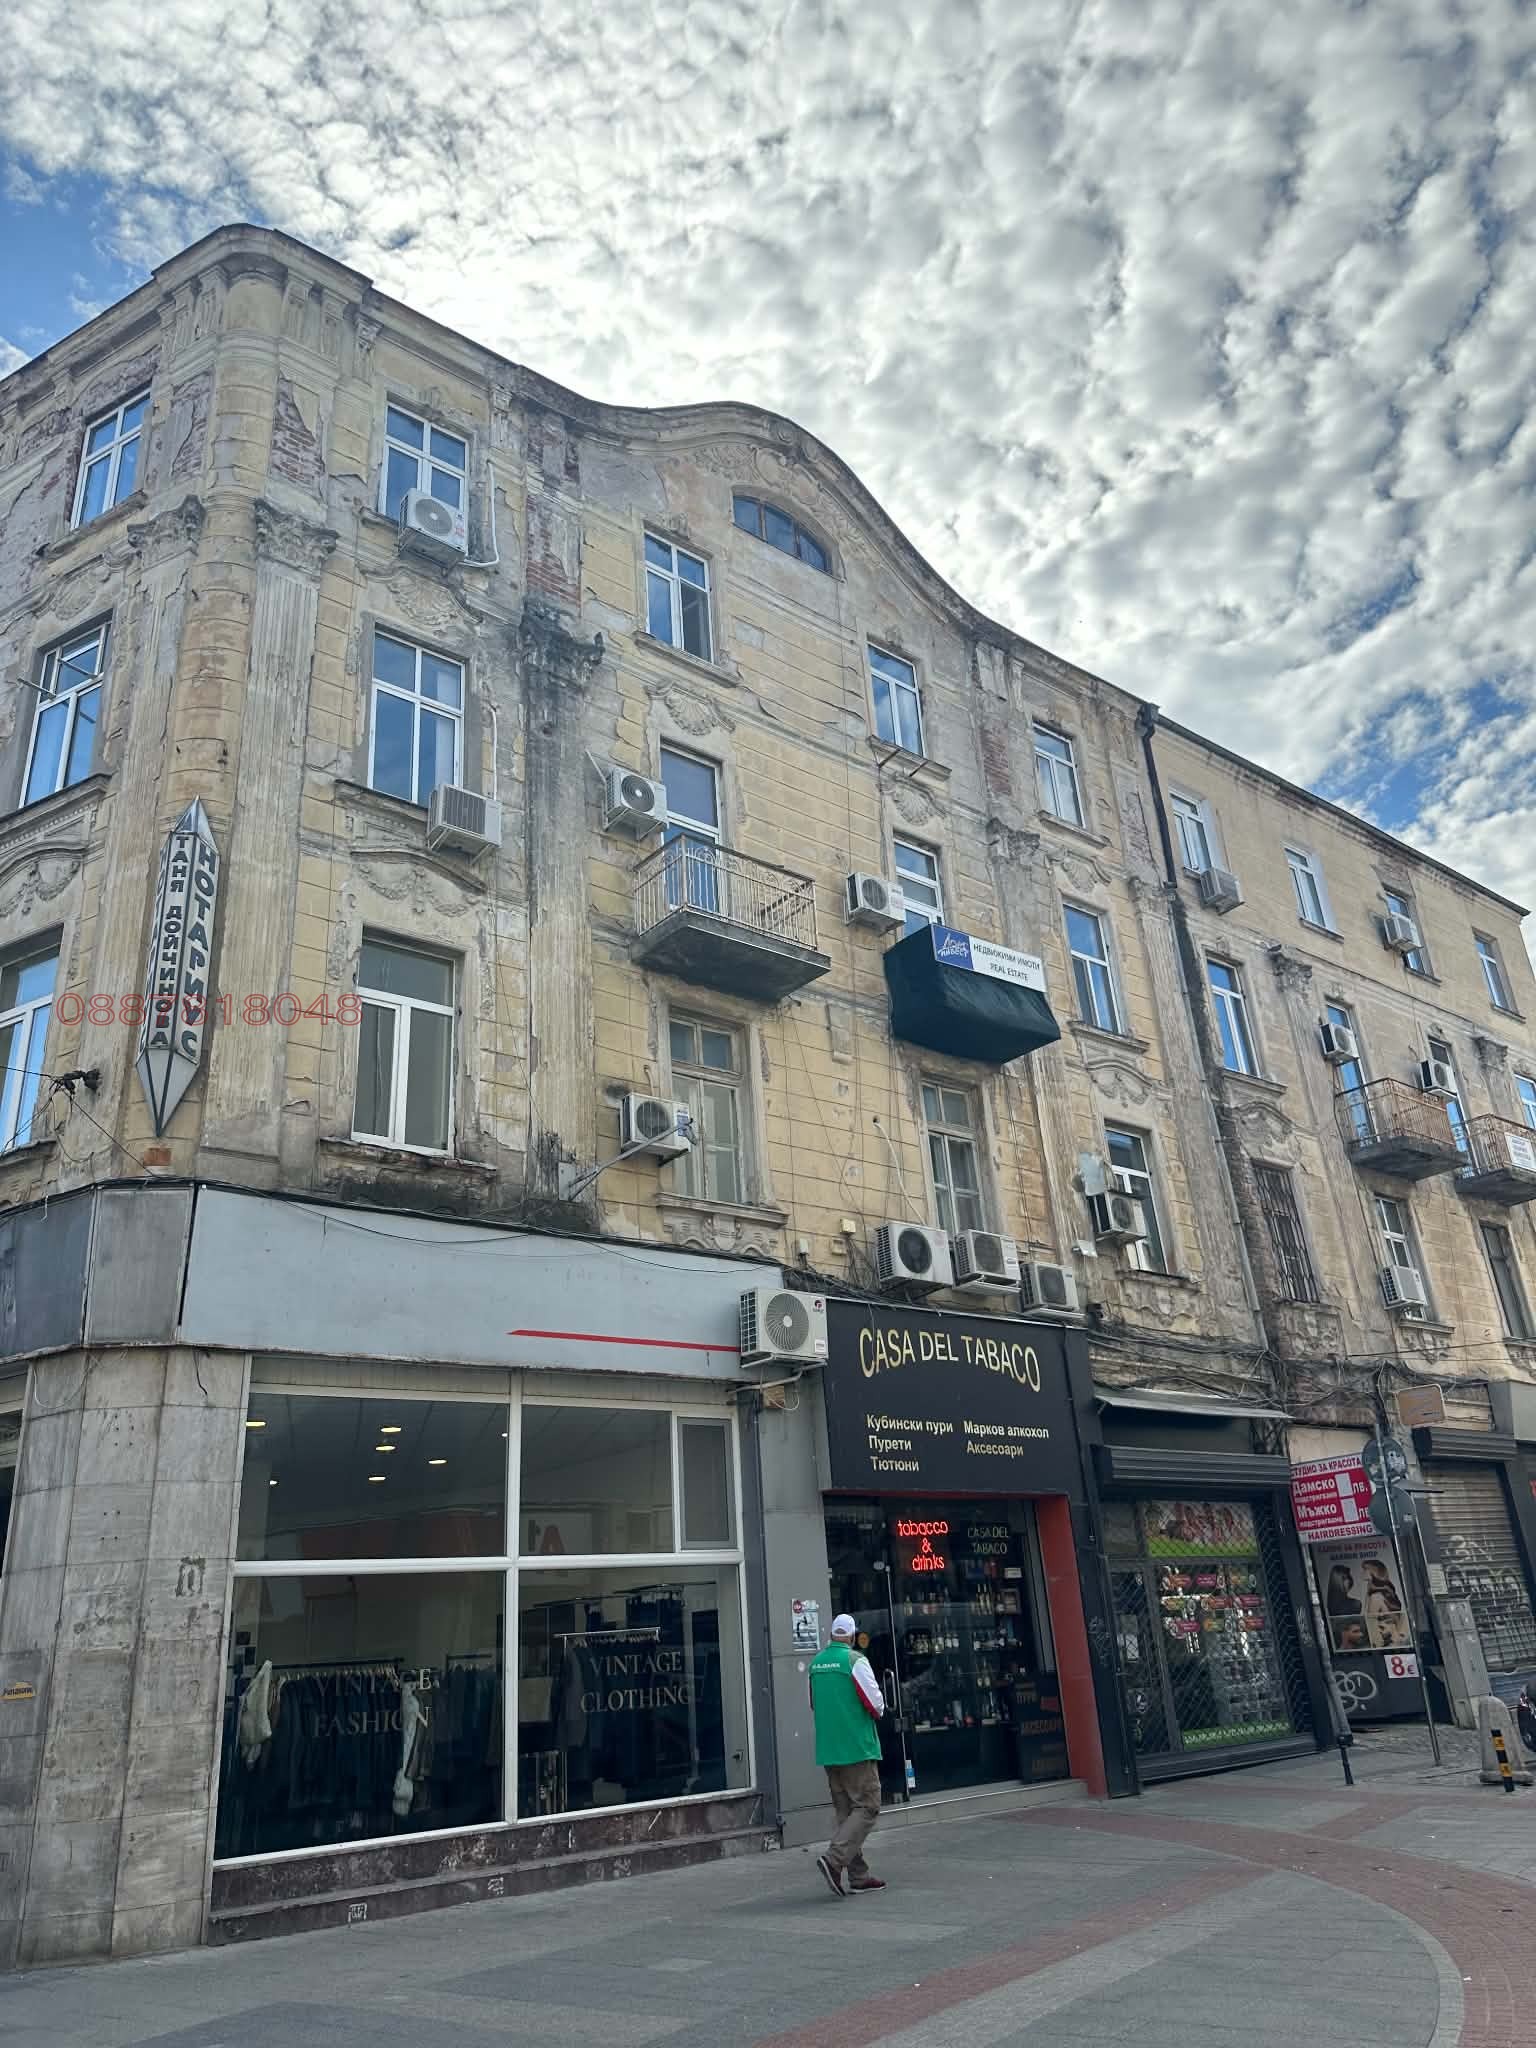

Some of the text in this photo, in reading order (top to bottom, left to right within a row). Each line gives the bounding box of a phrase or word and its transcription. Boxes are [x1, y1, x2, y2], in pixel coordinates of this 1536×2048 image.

[169, 836, 190, 893] ТАНЯ
[181, 842, 217, 1058] НОТАРИУС
[990, 962, 1029, 981] REAL ESTATE
[859, 1328, 1041, 1392] CASA DEL TABACO
[866, 1414, 954, 1434] Кубински пури
[963, 1420, 1050, 1439] Марков алкохол
[868, 1435, 912, 1453] Пурети
[966, 1440, 1024, 1458] Аксесоари
[870, 1456, 920, 1473] Тютюни
[1328, 1457, 1362, 1472] КРАСОТА
[1292, 1479, 1336, 1497] Дамско
[1297, 1503, 1337, 1519] Мъжко
[897, 1519, 949, 1537] tobacco
[967, 1526, 1009, 1538] CASA DEL
[1308, 1525, 1373, 1541] HAIRDRESSING
[921, 1538, 933, 1553] &
[973, 1542, 1008, 1555] TABACO
[912, 1556, 945, 1572] drinks
[589, 1650, 683, 1677] VINTAGE
[580, 1685, 692, 1714] CLOTHING
